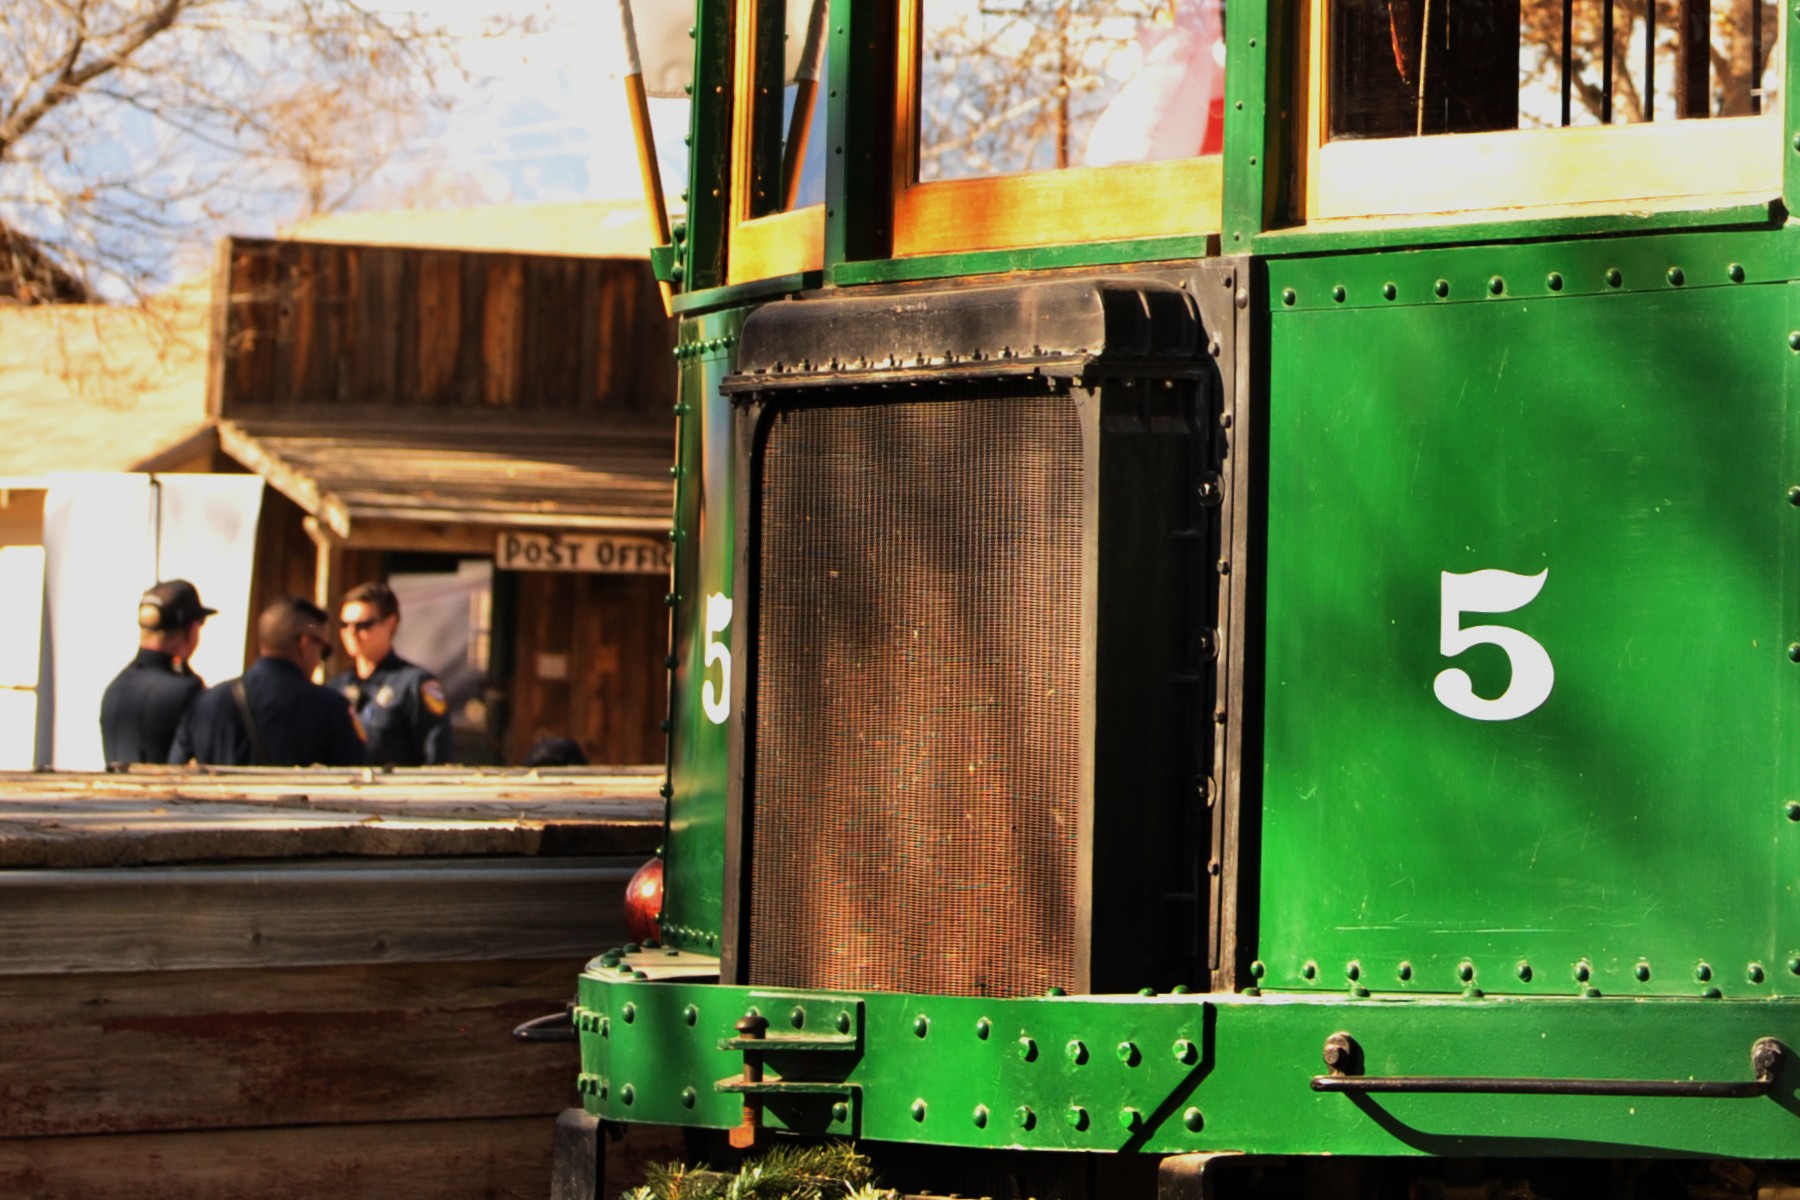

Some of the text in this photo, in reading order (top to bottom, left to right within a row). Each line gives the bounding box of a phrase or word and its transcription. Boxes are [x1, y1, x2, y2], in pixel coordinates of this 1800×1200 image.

[504, 532, 672, 569] POST OFFIC
[702, 592, 733, 725] 5
[1434, 569, 1555, 721] 5
